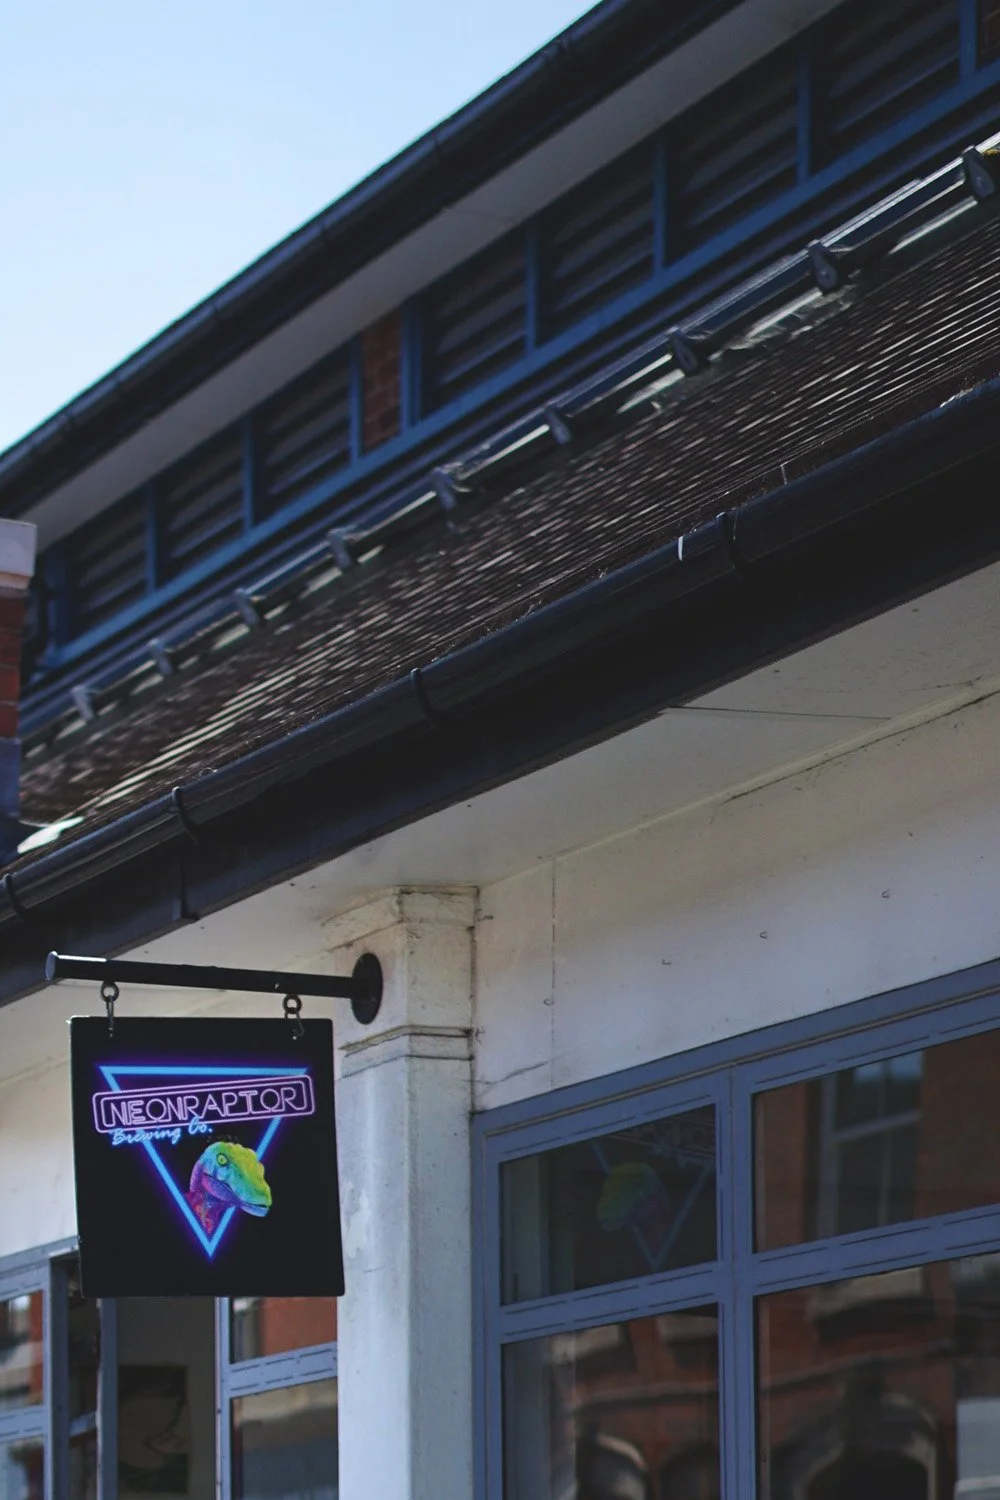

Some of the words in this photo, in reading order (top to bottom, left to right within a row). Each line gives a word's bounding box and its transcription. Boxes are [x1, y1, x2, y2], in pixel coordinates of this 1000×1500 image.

[109, 1086, 300, 1127] NEONRAPTOR
[111, 1126, 181, 1145] Brewing
[188, 1116, 213, 1135] Co.
